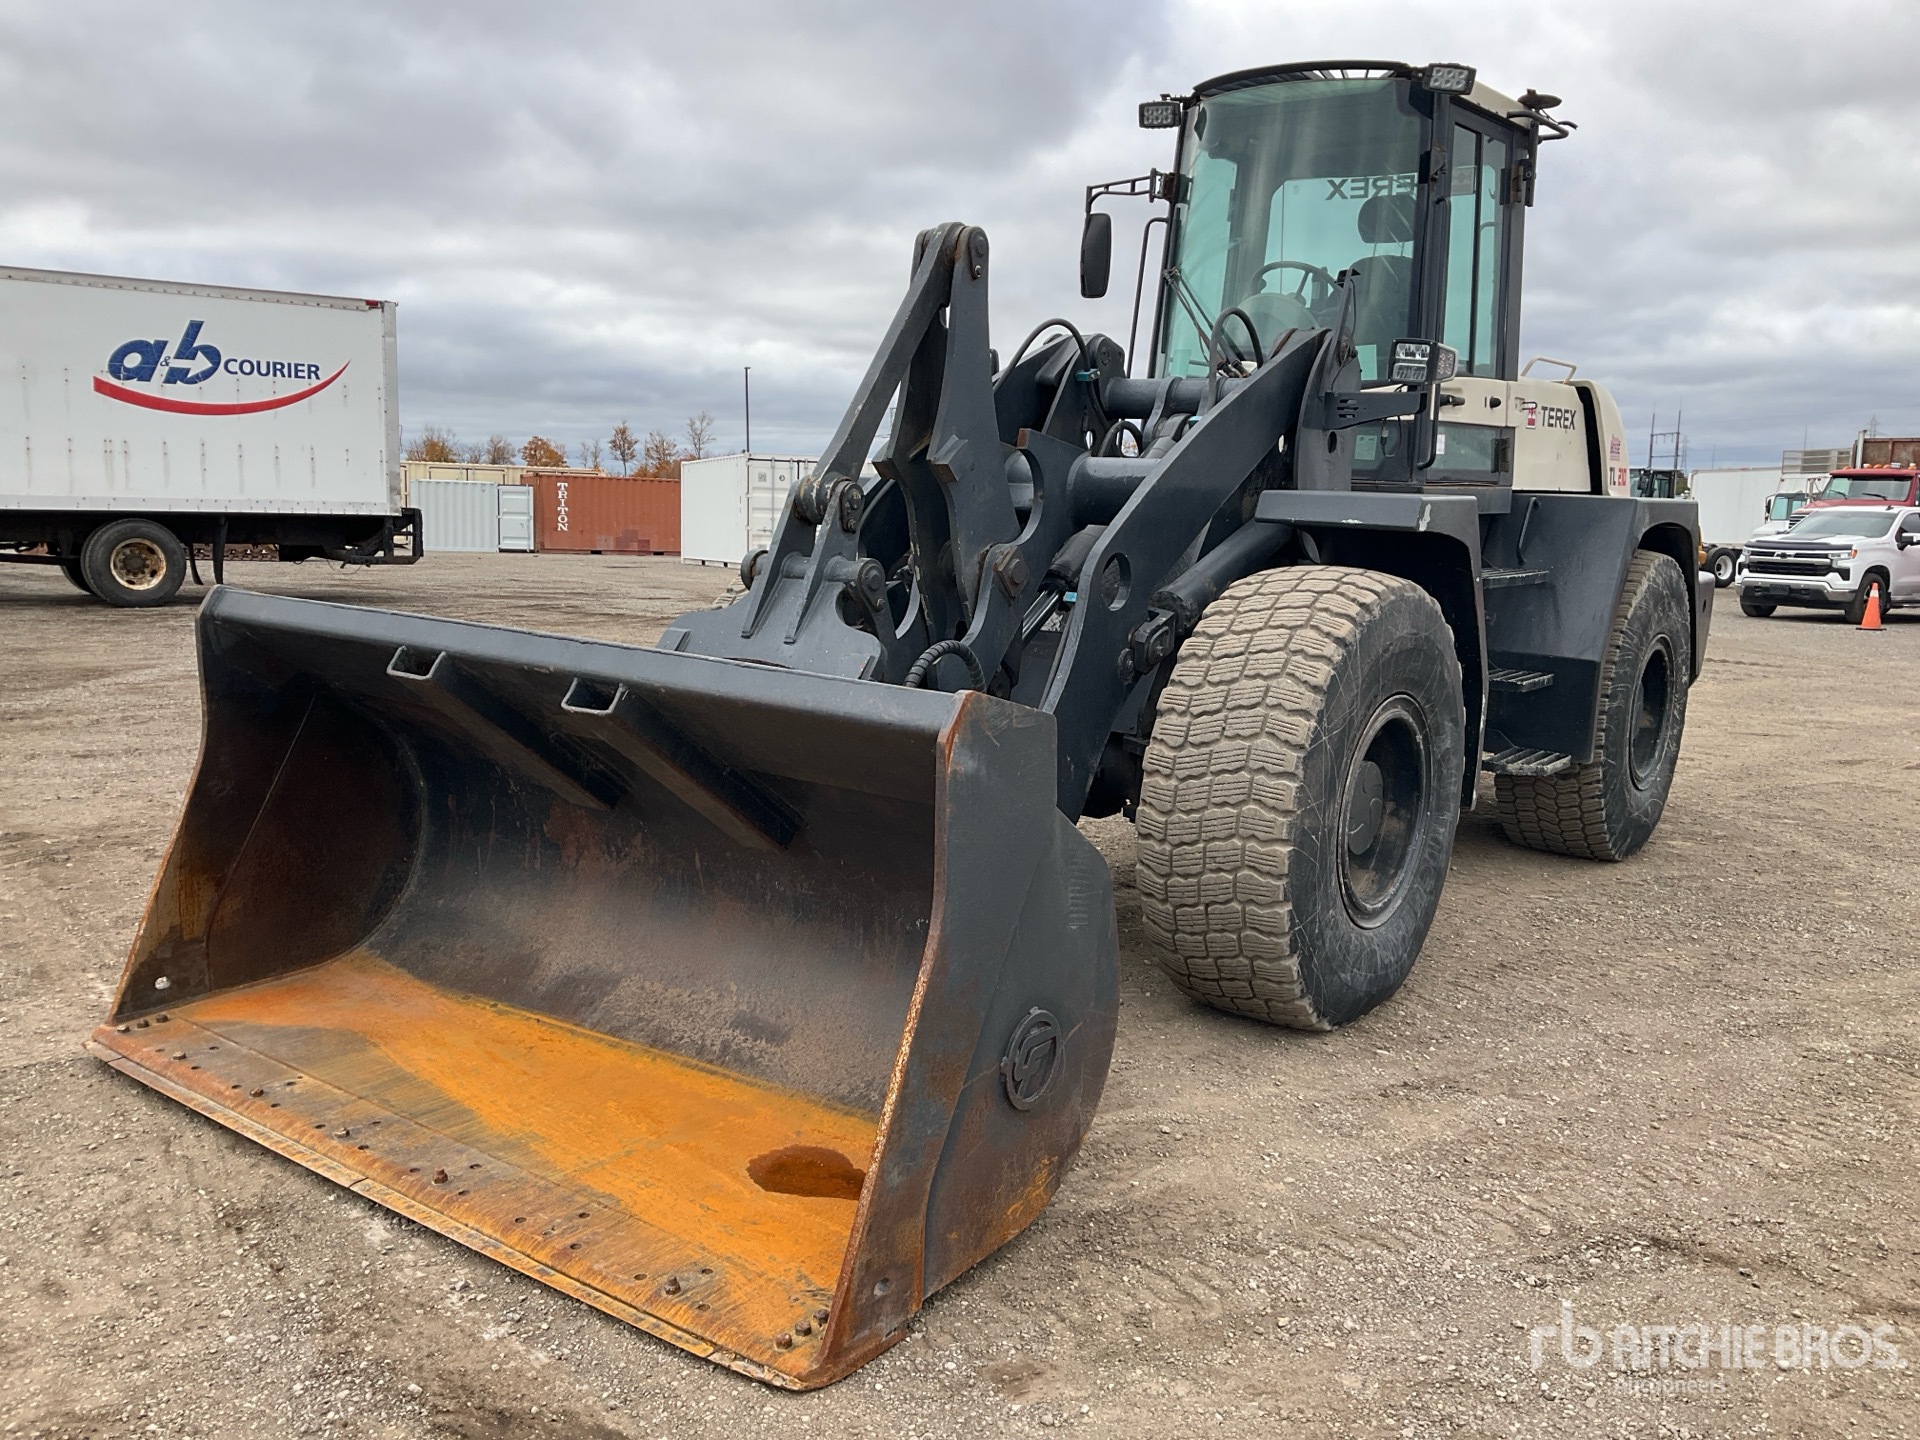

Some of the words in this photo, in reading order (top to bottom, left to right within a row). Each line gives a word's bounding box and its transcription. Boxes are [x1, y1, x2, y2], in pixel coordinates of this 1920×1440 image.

[223, 357, 321, 381] COURIER
[1541, 405, 1577, 430] TEREX
[557, 482, 569, 532] TRITON
